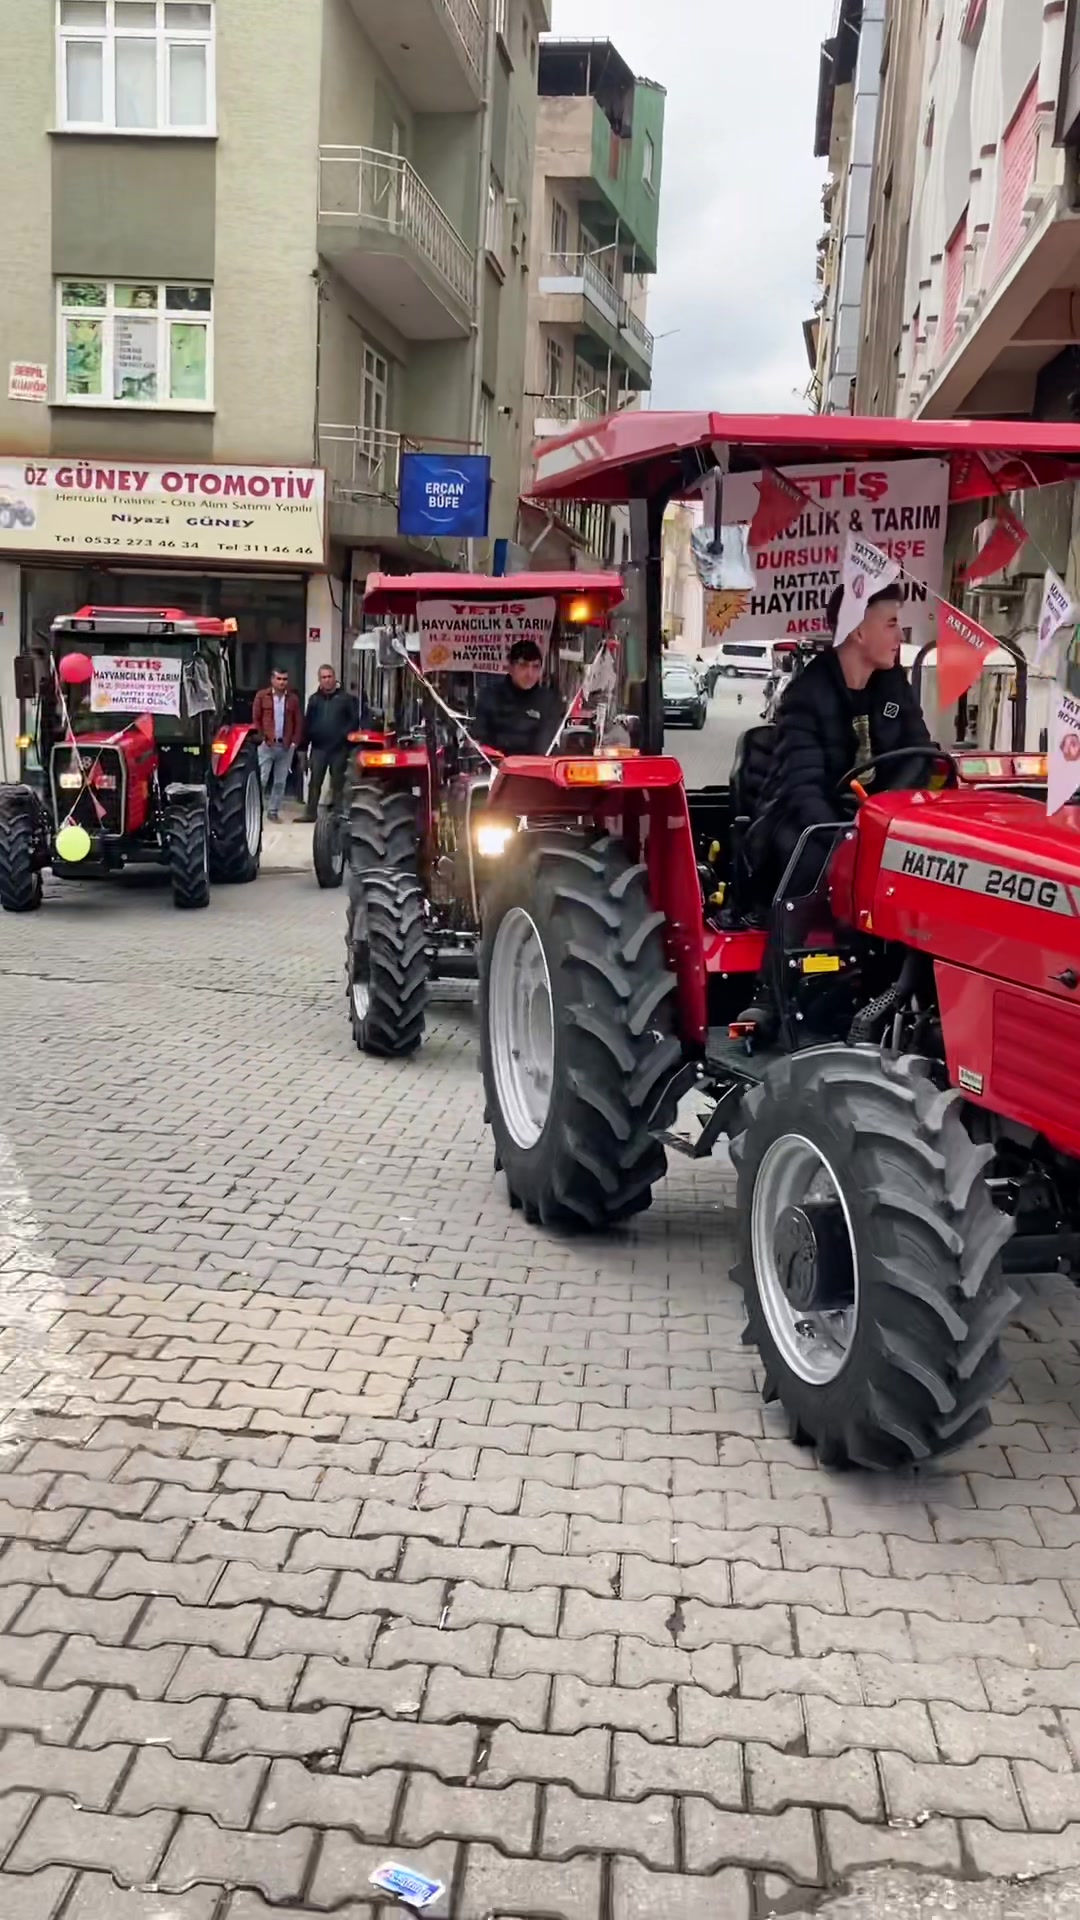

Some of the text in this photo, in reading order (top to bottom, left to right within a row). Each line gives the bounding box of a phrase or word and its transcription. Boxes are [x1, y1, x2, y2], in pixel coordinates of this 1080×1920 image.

[24, 462, 314, 499] ÖZ GÜNEY OTOMOTİV
[425, 482, 464, 495] ERCAN
[786, 467, 889, 503] ETİŞ
[171, 498, 196, 508] Oto
[428, 494, 459, 508] BÜFE
[111, 514, 255, 528] Niyazi GÜNEY
[849, 509, 863, 532] &
[871, 505, 941, 532] TARIM
[84, 536, 121, 546] 0532
[158, 540, 176, 548] 46
[181, 541, 199, 549] 34
[756, 545, 838, 569] DURSUN
[773, 570, 840, 590] HATTAT
[751, 588, 829, 615] HAYIRL
[421, 618, 501, 631] HAYVANCILIK
[505, 618, 514, 631] &
[94, 670, 146, 681] HAYVANCILIK
[157, 673, 179, 682] TARIM
[902, 850, 1058, 909] HATTAT 240G
